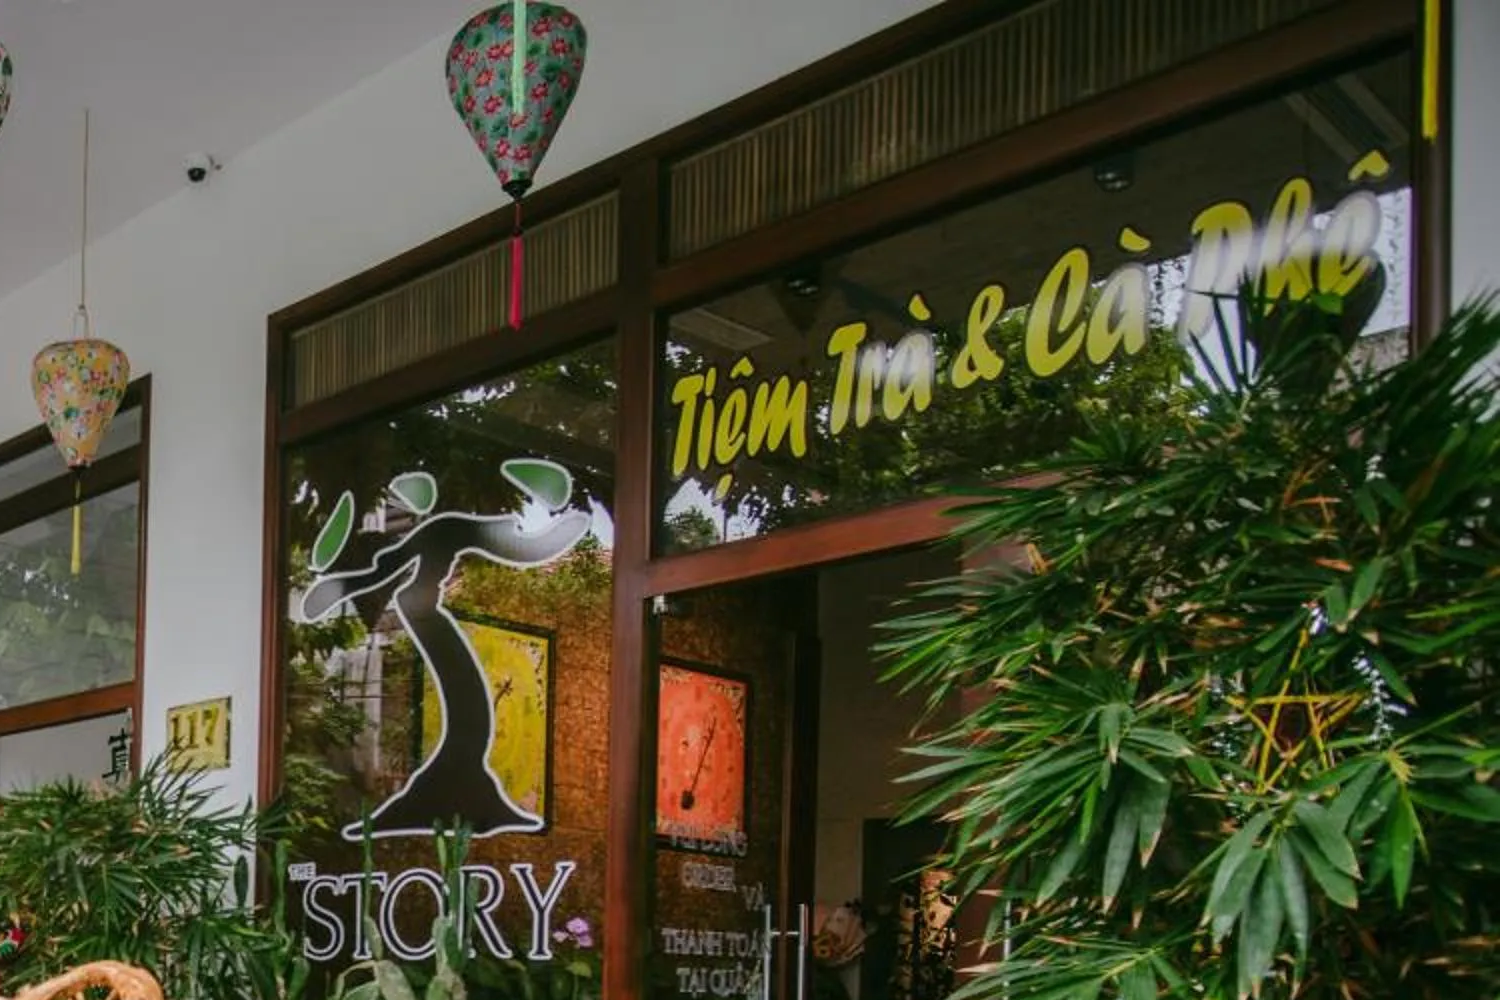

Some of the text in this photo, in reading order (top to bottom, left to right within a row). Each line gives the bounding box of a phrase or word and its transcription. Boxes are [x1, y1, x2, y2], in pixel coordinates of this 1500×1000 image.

[672, 150, 1390, 500] Tiệm Trà & Cà Phê
[170, 704, 220, 748] 117
[288, 862, 316, 880] THE
[303, 862, 577, 961] STORY
[661, 927, 723, 957] THANH
